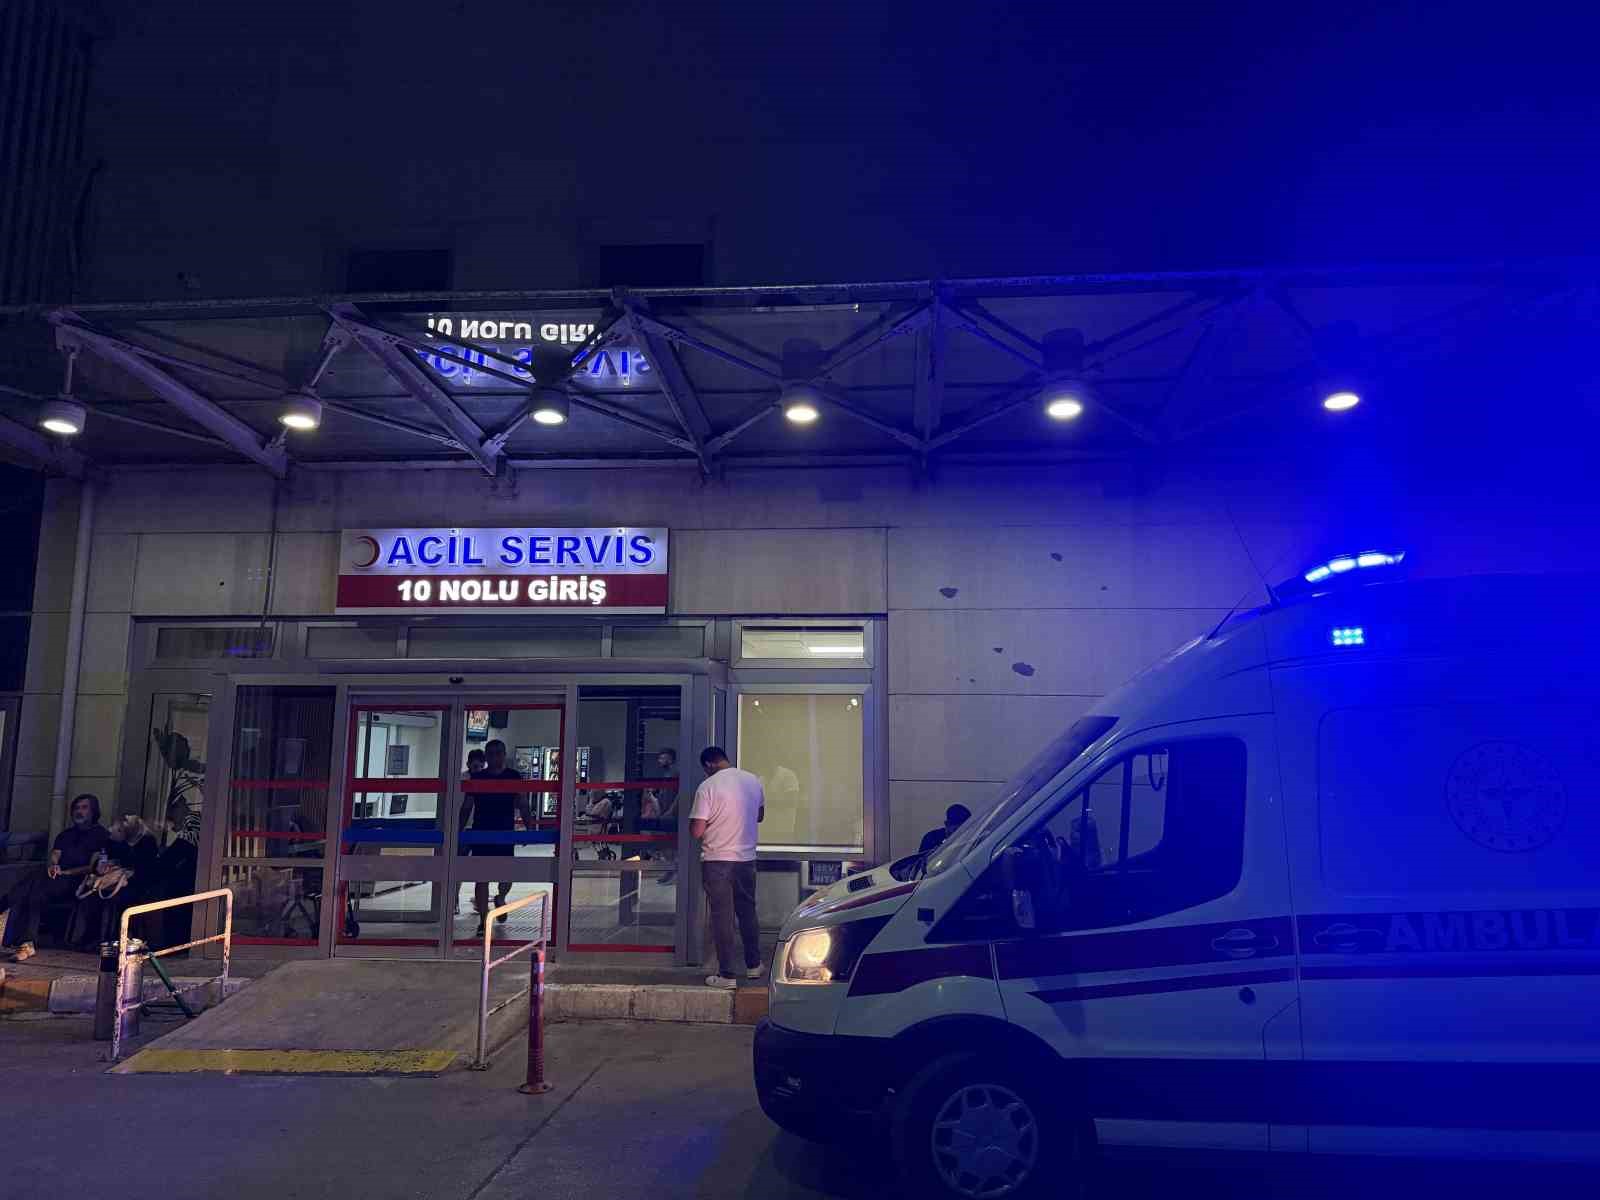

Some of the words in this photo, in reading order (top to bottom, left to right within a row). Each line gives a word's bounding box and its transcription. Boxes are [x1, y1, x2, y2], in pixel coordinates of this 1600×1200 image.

[386, 529, 487, 567] ACİL
[500, 528, 656, 567] SERVİS
[397, 579, 431, 602] 10
[439, 580, 519, 602] NOLU
[528, 576, 607, 604] GİRİŞ
[1385, 910, 1600, 951] AMBUL
